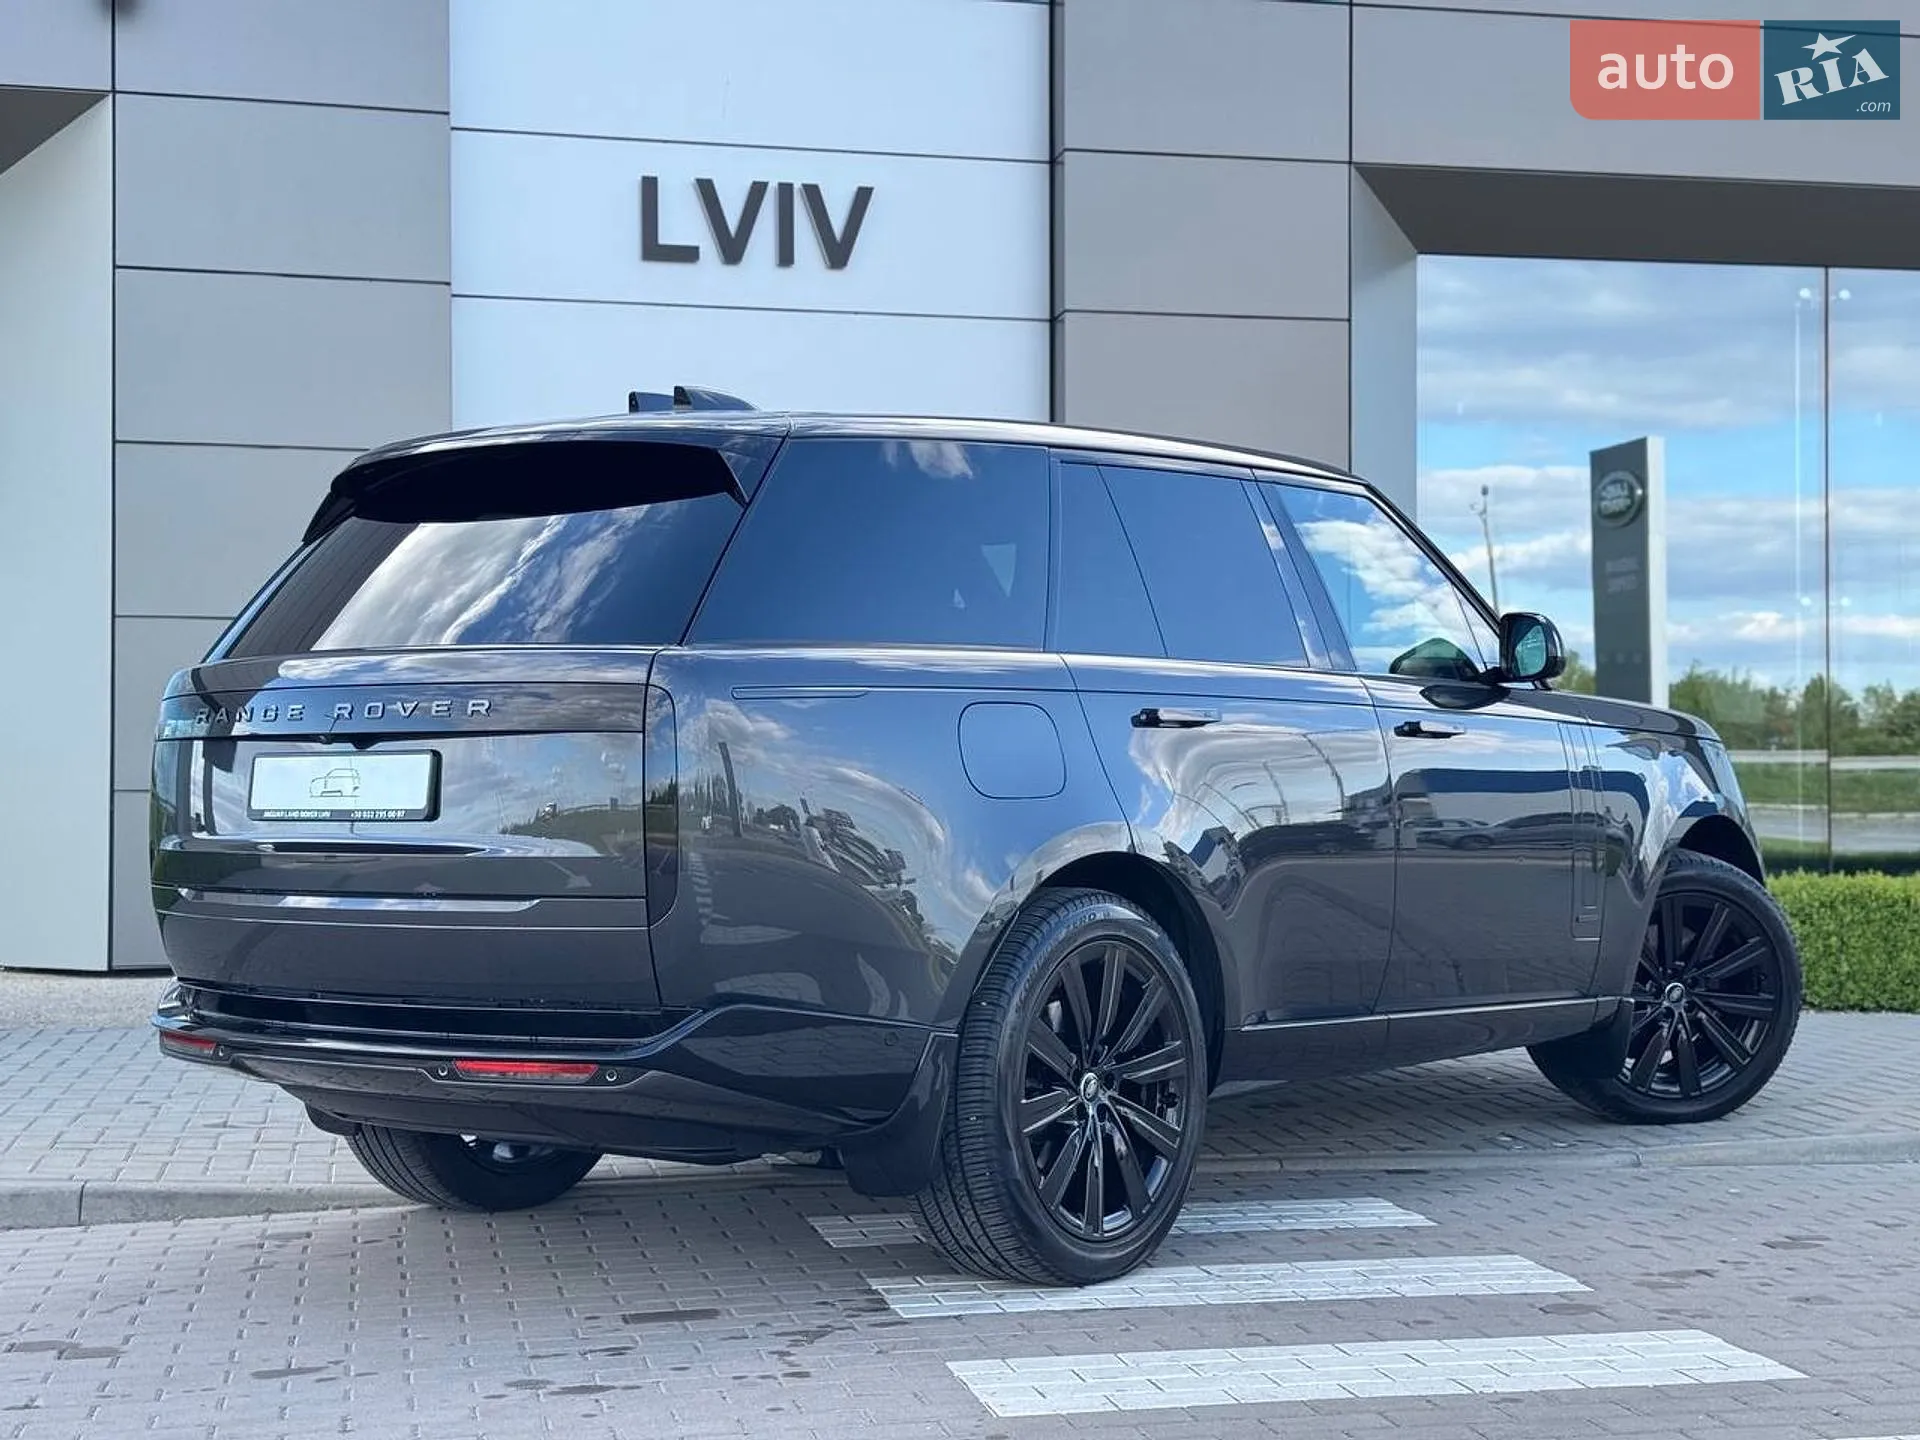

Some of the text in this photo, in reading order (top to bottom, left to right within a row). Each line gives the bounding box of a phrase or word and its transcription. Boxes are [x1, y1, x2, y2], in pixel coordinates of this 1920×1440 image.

[640, 175, 875, 270] LVIV
[195, 699, 493, 725] RANGE ROVER
